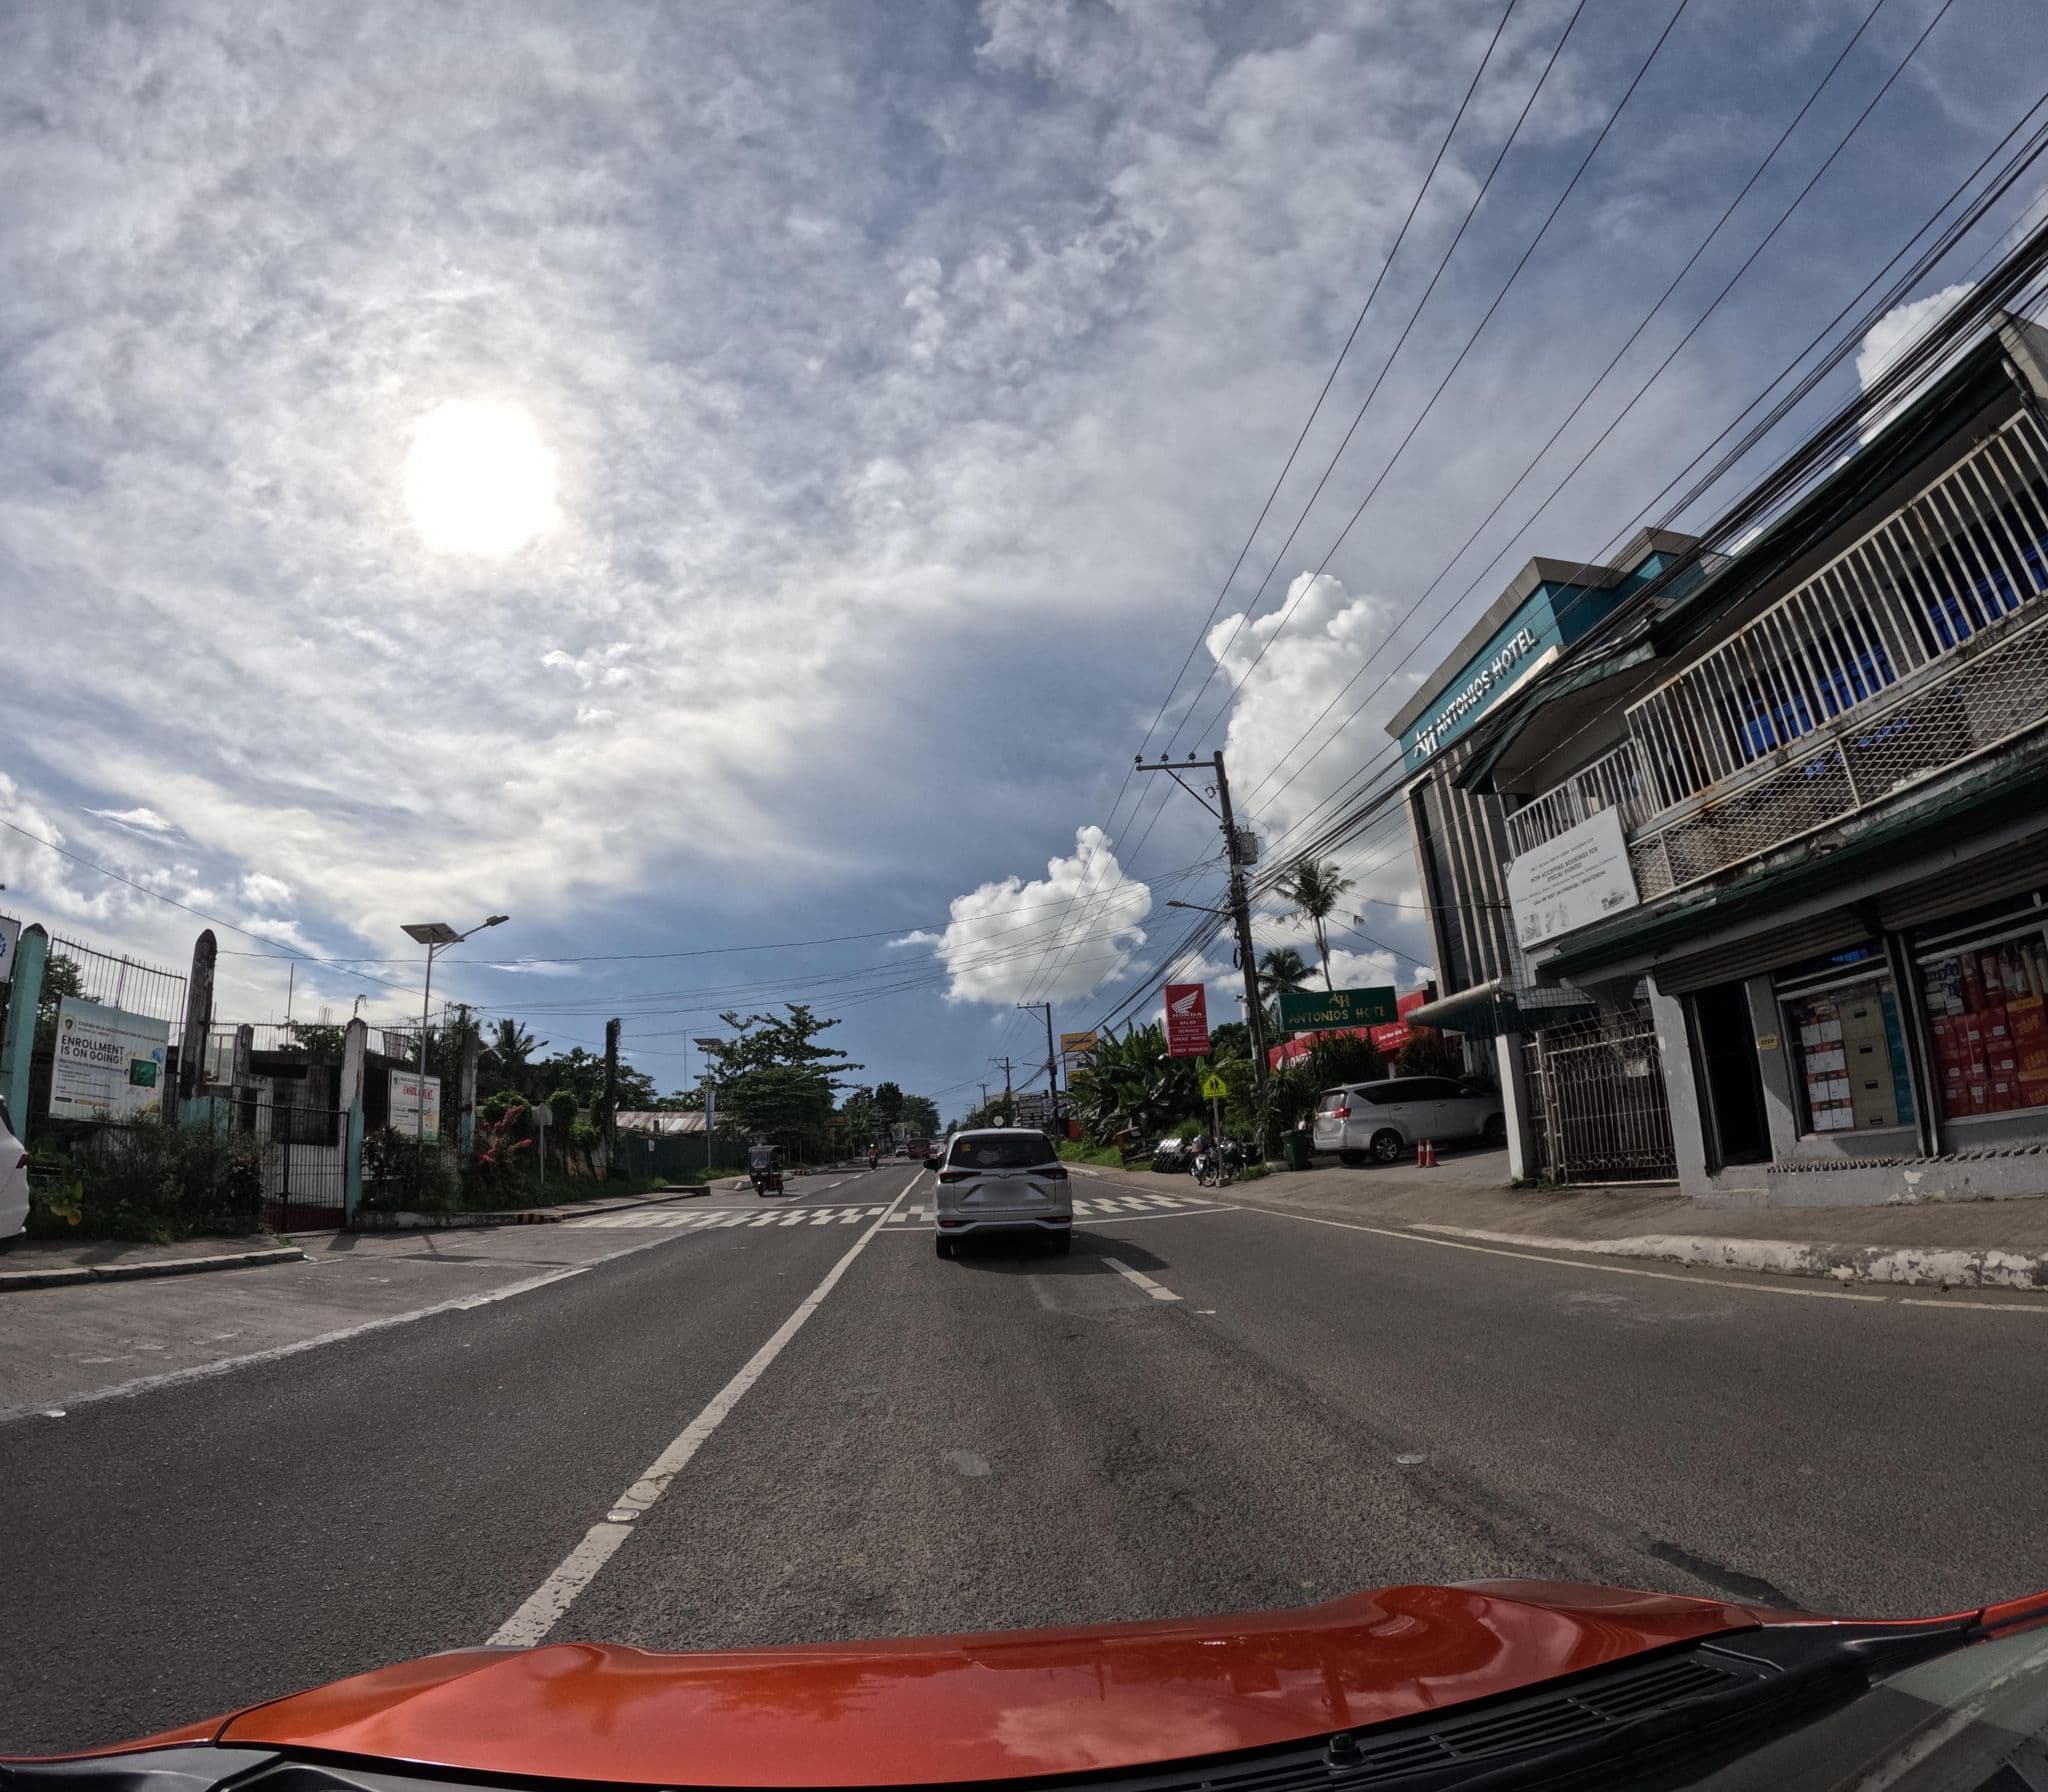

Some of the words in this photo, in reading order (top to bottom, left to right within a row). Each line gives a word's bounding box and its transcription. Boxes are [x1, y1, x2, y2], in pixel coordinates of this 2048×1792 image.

[1436, 670, 1491, 737] ANTONIOS
[1491, 627, 1536, 680] HOTEL
[1541, 863, 1565, 878] ACCEPTING
[1565, 851, 1589, 867] BOOKINGS
[1588, 846, 1599, 857] FOR
[1289, 1009, 1349, 1025] ANTONIOS
[60, 1045, 70, 1056] IS
[72, 1047, 87, 1059] ON
[89, 1050, 123, 1065] GOING!
[61, 1034, 125, 1056] ENROLLMENT
